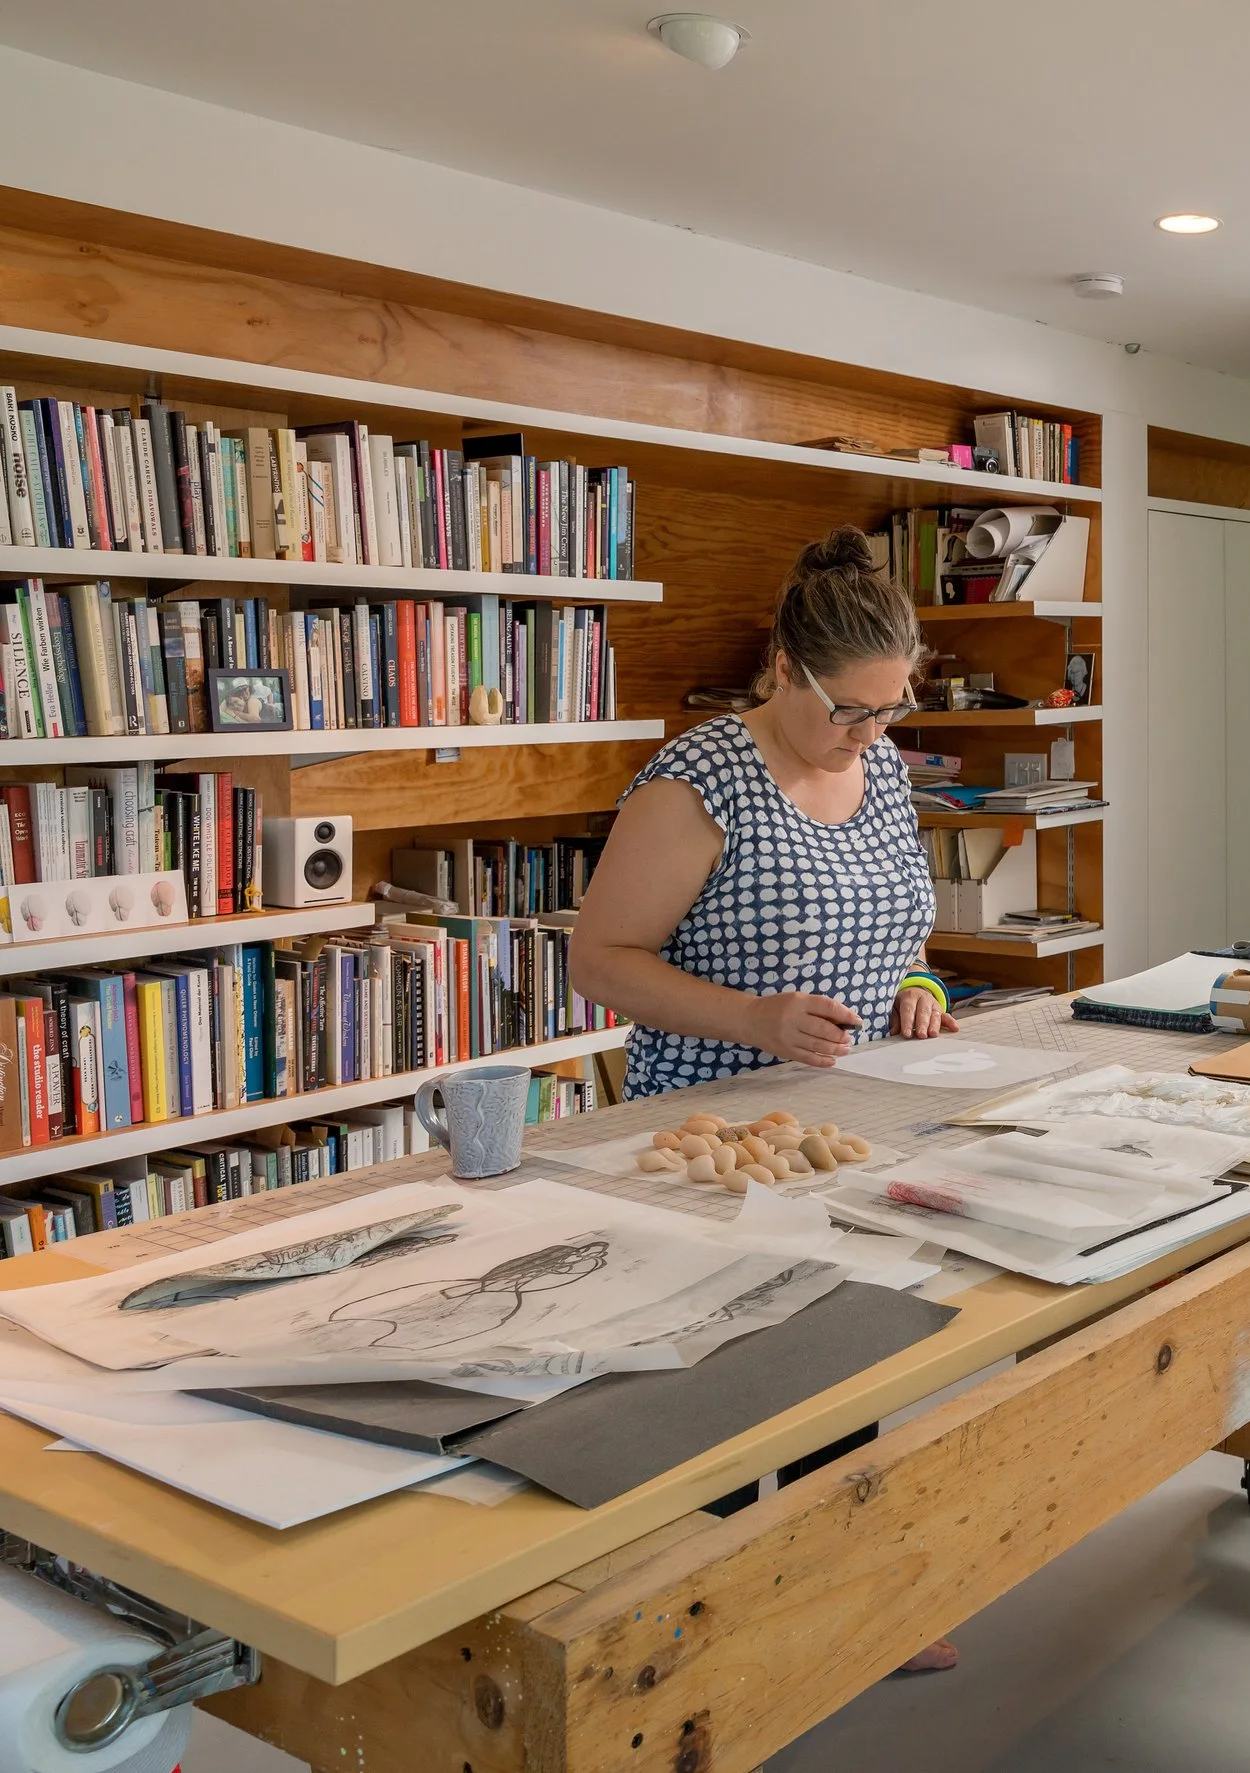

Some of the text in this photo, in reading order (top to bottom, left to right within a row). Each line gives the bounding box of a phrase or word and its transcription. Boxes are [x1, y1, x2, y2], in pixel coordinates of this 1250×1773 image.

[6, 393, 18, 441] BART KOSKO
[141, 428, 149, 457] CLAUDE
[13, 453, 28, 498] noise
[270, 456, 280, 493] LABYRINTHS
[190, 481, 202, 500] play
[147, 489, 157, 537] DISAVOWALS
[560, 522, 568, 535] Jim
[37, 608, 50, 671] Wie Farben wirken
[297, 621, 305, 646] blink
[342, 632, 351, 643] Gift
[11, 633, 30, 698] SILENCE
[53, 632, 66, 684] Ecopsychology
[108, 651, 118, 689] BALDNESS
[388, 660, 396, 687] CHAOS
[45, 683, 56, 717] Eva Heller
[122, 791, 137, 828] choosing
[125, 830, 137, 847] craft
[225, 827, 231, 838] TO
[75, 840, 88, 870] Traumatic
[193, 860, 199, 871] ME
[59, 1006, 67, 1028] theory
[343, 993, 351, 1016] Women
[396, 999, 402, 1011] AS
[342, 1022, 351, 1047] Wisdom
[33, 1044, 41, 1060] the
[34, 1061, 43, 1089] studio
[52, 1063, 60, 1105] A POWER
[35, 1091, 44, 1118] reader
